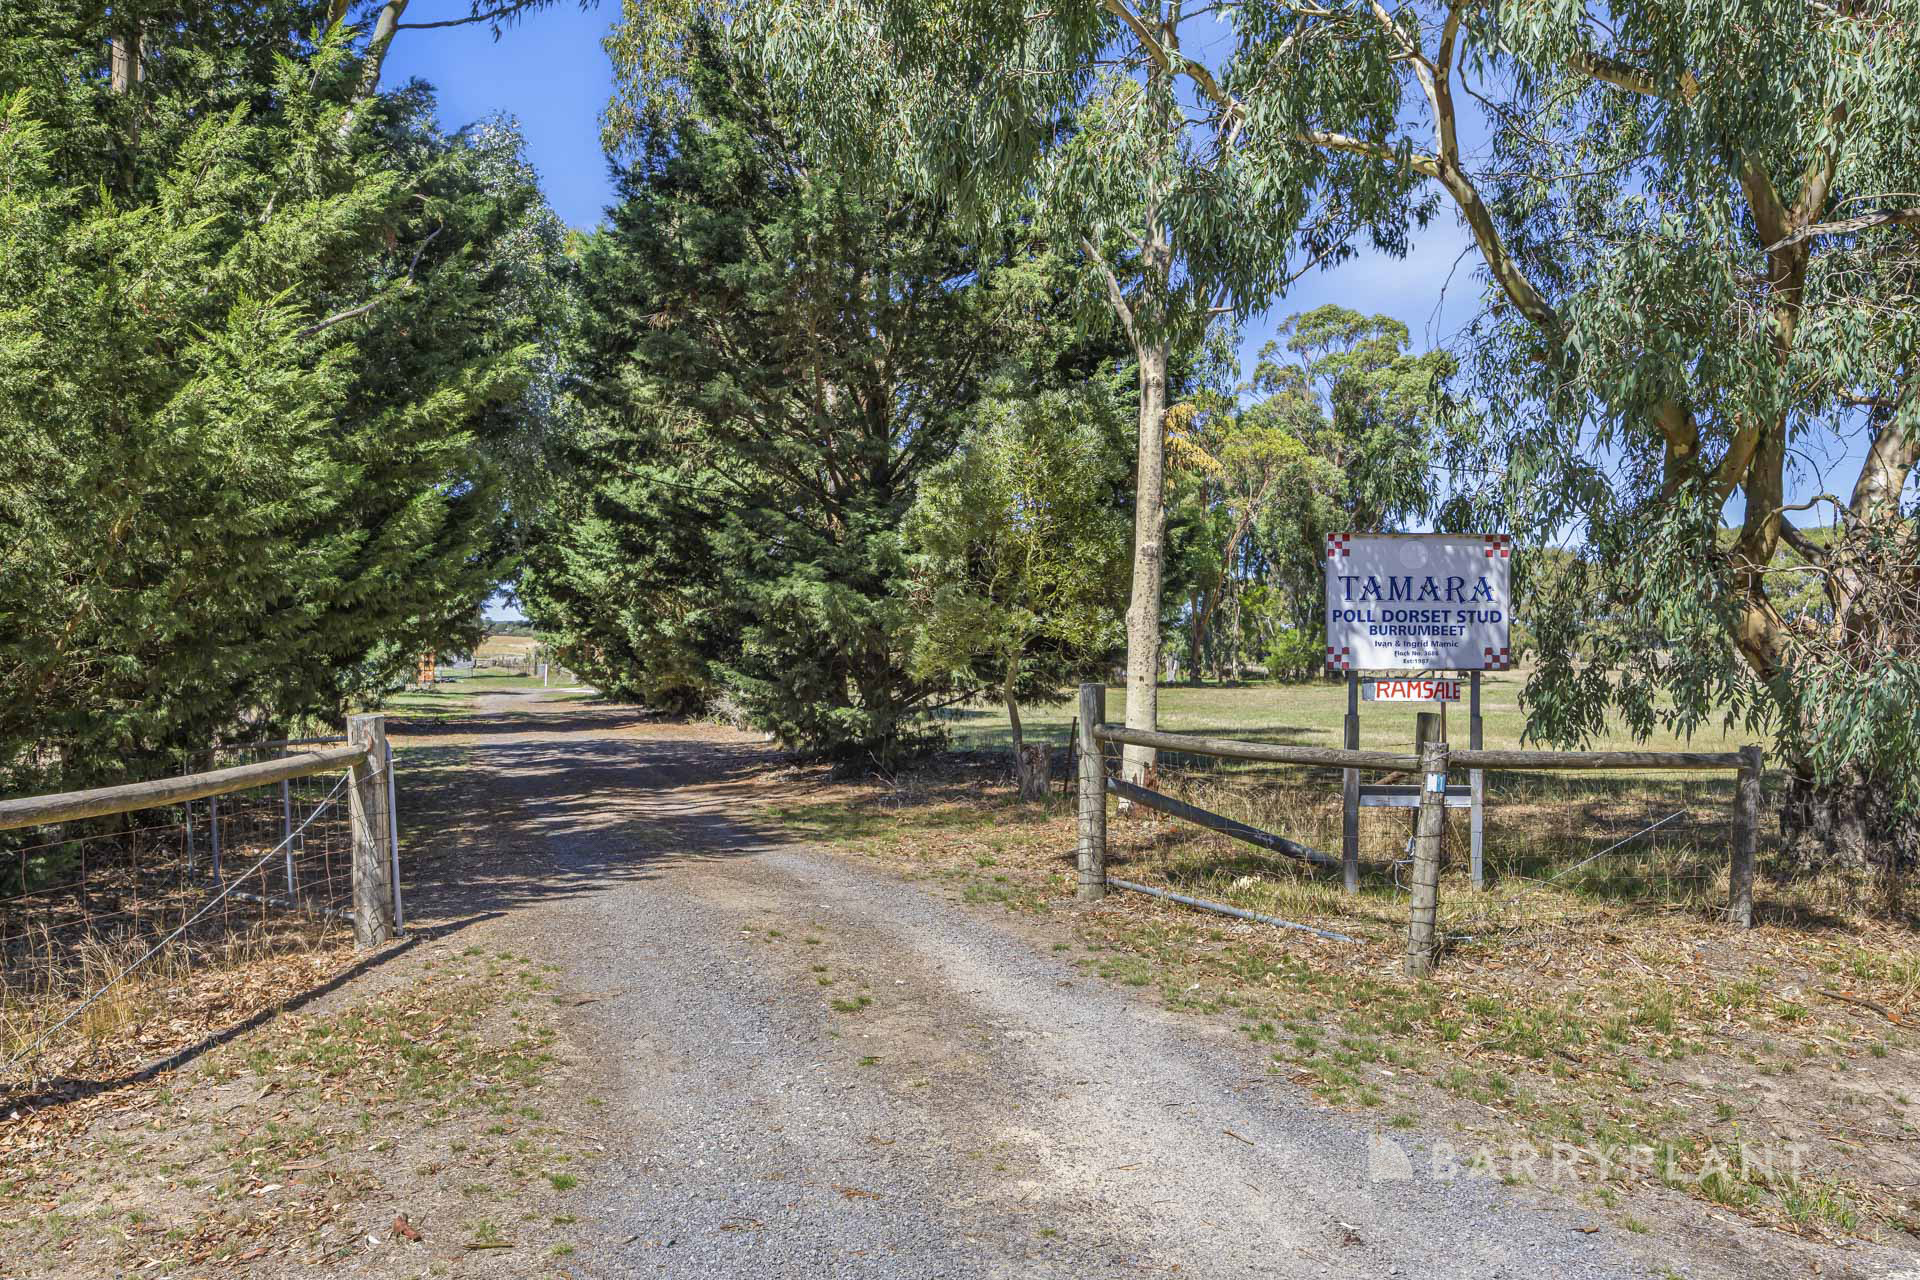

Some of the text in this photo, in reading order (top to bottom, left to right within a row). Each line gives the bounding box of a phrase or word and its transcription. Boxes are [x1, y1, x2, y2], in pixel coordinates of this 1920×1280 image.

[1338, 575, 1496, 604] TAMARA
[1332, 609, 1502, 624] POLL DORSET STUD
[1369, 624, 1466, 636] BURRUMBEET
[1374, 639, 1459, 649] Ivan & Ingrid Mamic
